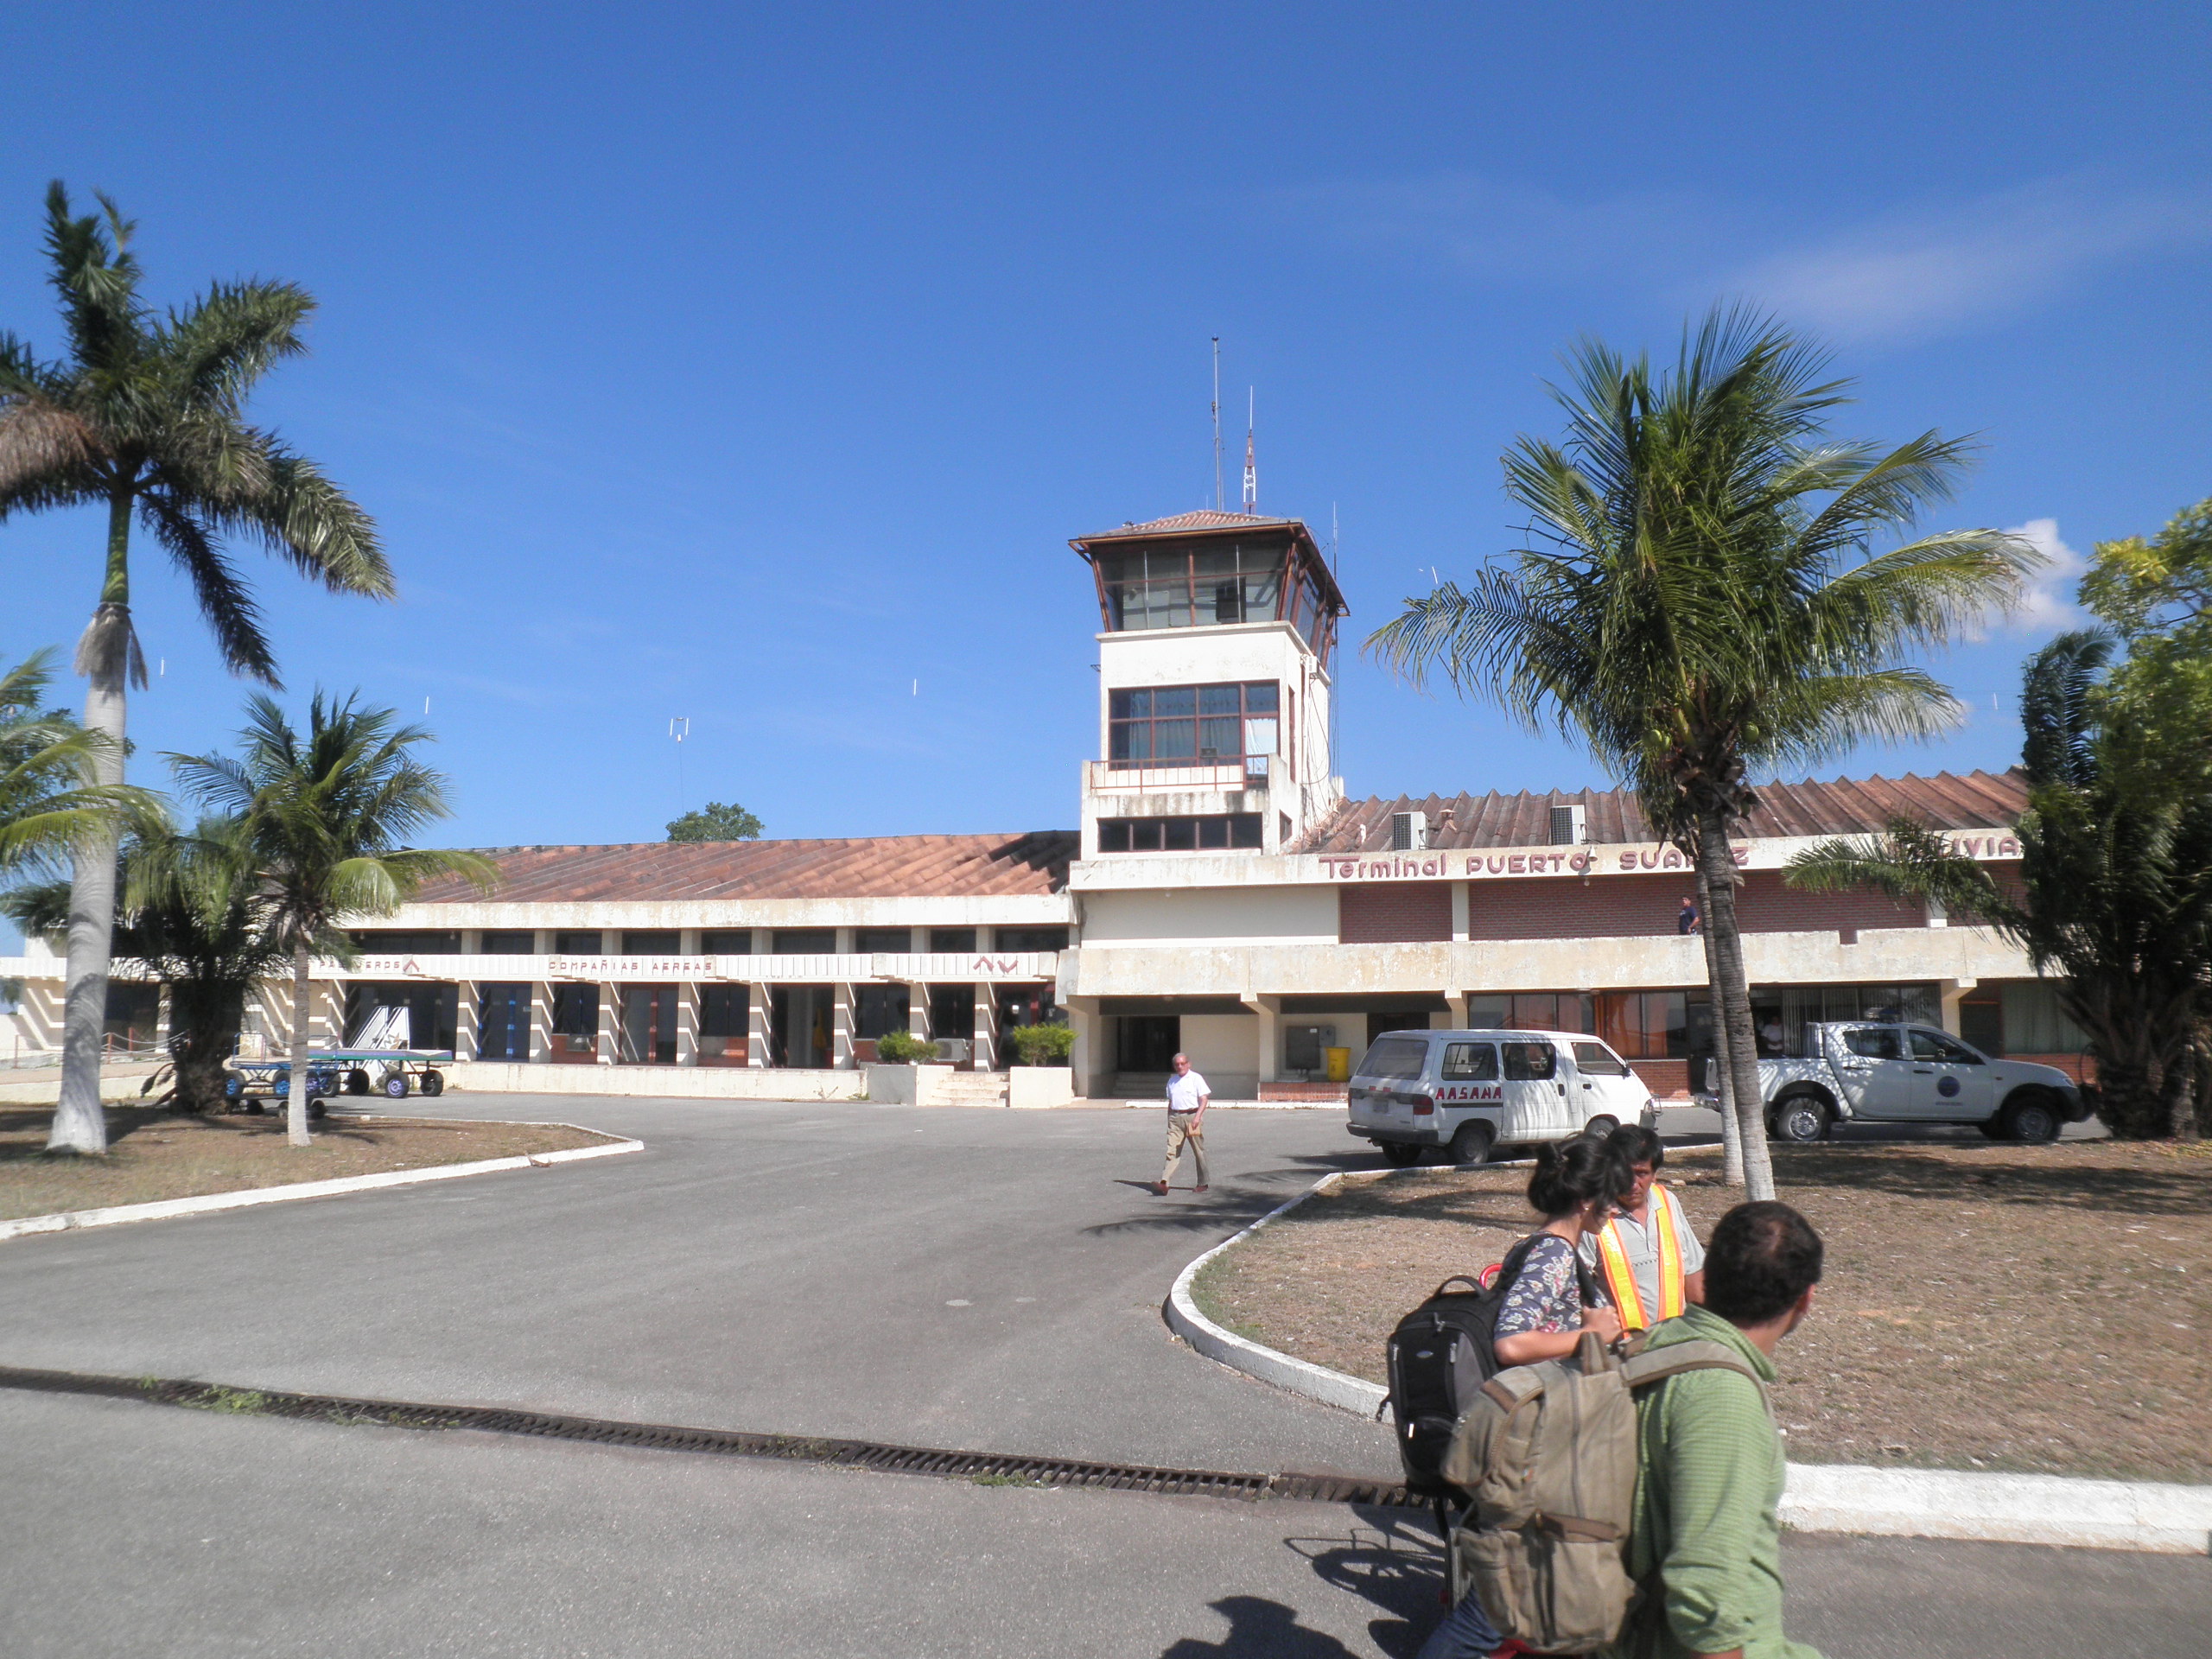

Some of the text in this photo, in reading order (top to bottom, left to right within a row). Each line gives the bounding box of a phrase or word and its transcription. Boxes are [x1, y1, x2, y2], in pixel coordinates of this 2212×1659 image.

[1319, 853, 1446, 879] Terminal
[1466, 852, 1587, 875] PUERTO
[1619, 847, 1749, 871] SUAZ
[549, 960, 712, 970] COMPAÑIAS AEREAS
[1435, 1086, 1502, 1100] AASANA
